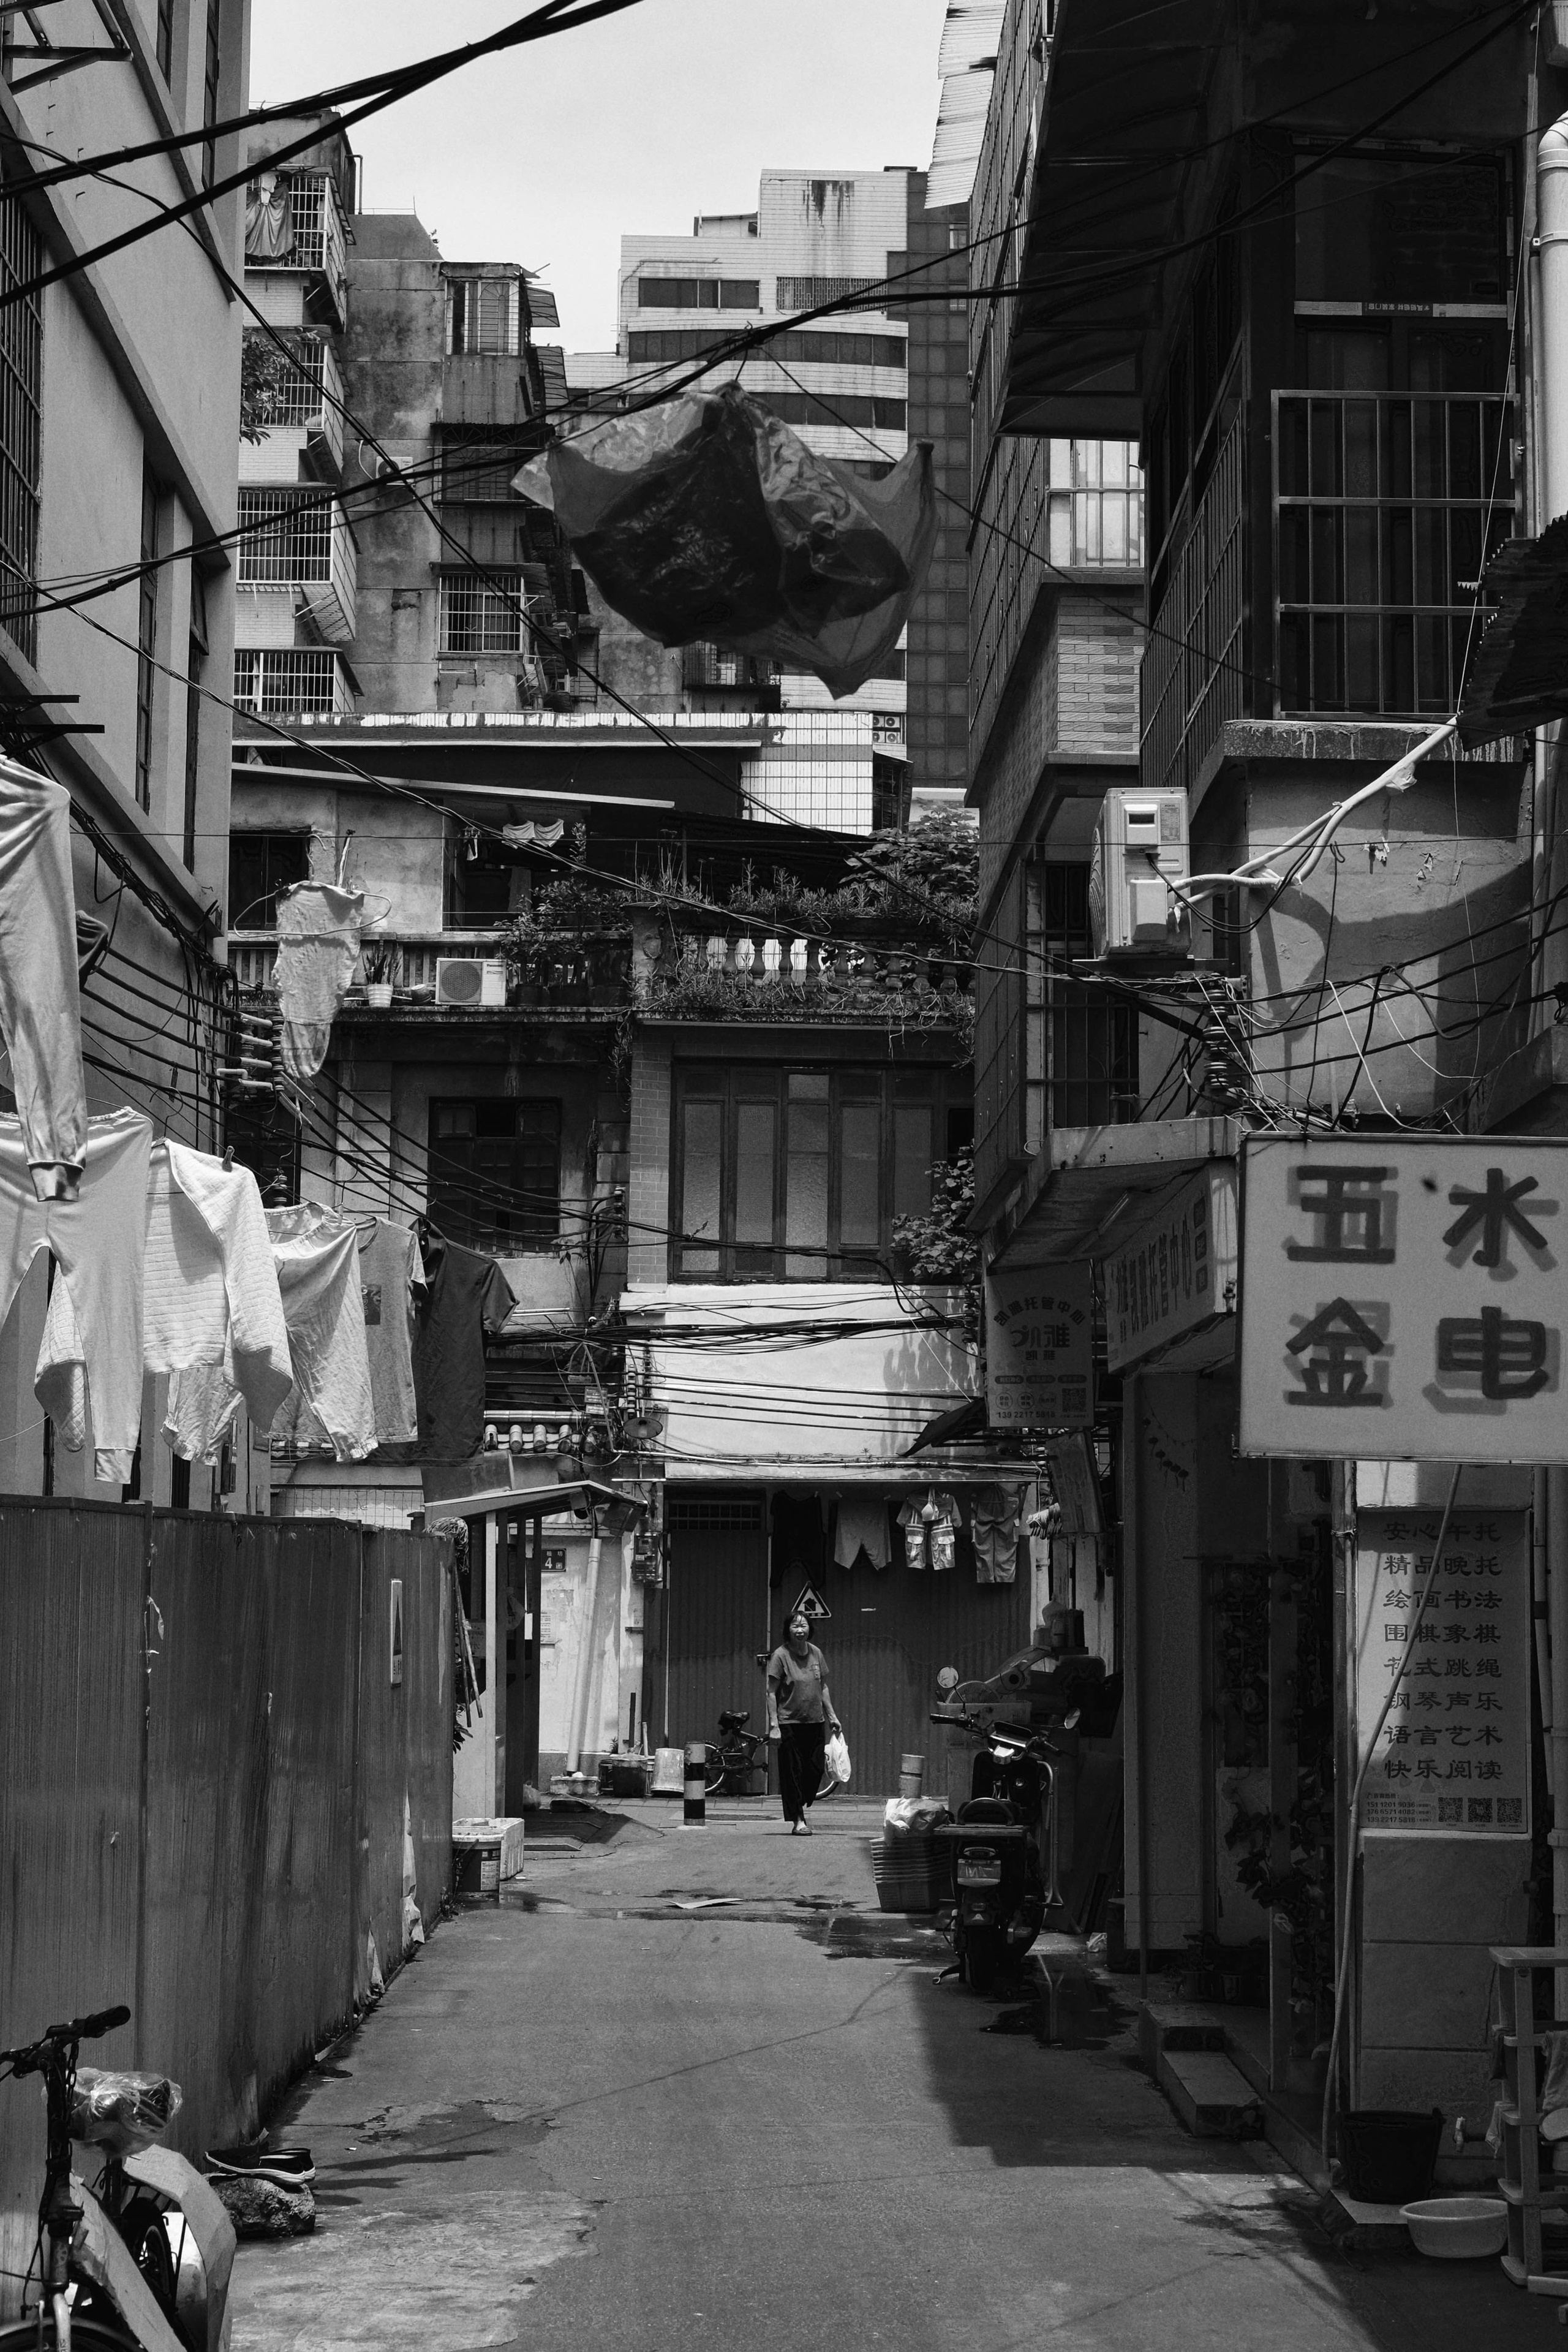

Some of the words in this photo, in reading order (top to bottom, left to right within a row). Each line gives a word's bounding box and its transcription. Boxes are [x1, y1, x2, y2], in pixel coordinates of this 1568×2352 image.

[1286, 1165, 1395, 1407] 五金
[1439, 1168, 1548, 1400] 水电
[993, 1296, 1085, 1326] 凯雅托管中心
[1025, 1350, 1055, 1361] 凯雅
[1383, 1521, 1502, 1542] 安心午托
[1383, 1555, 1502, 1576] 精品晚托
[1383, 1589, 1503, 1609] 绘画书法
[1384, 1623, 1502, 1644] 围棋象棋
[1384, 1657, 1502, 1678] 花式跳绳
[1384, 1691, 1503, 1711] 钢琴声乐
[1384, 1725, 1504, 1746] 语言艺术
[1384, 1759, 1504, 1780] 快乐阅读
